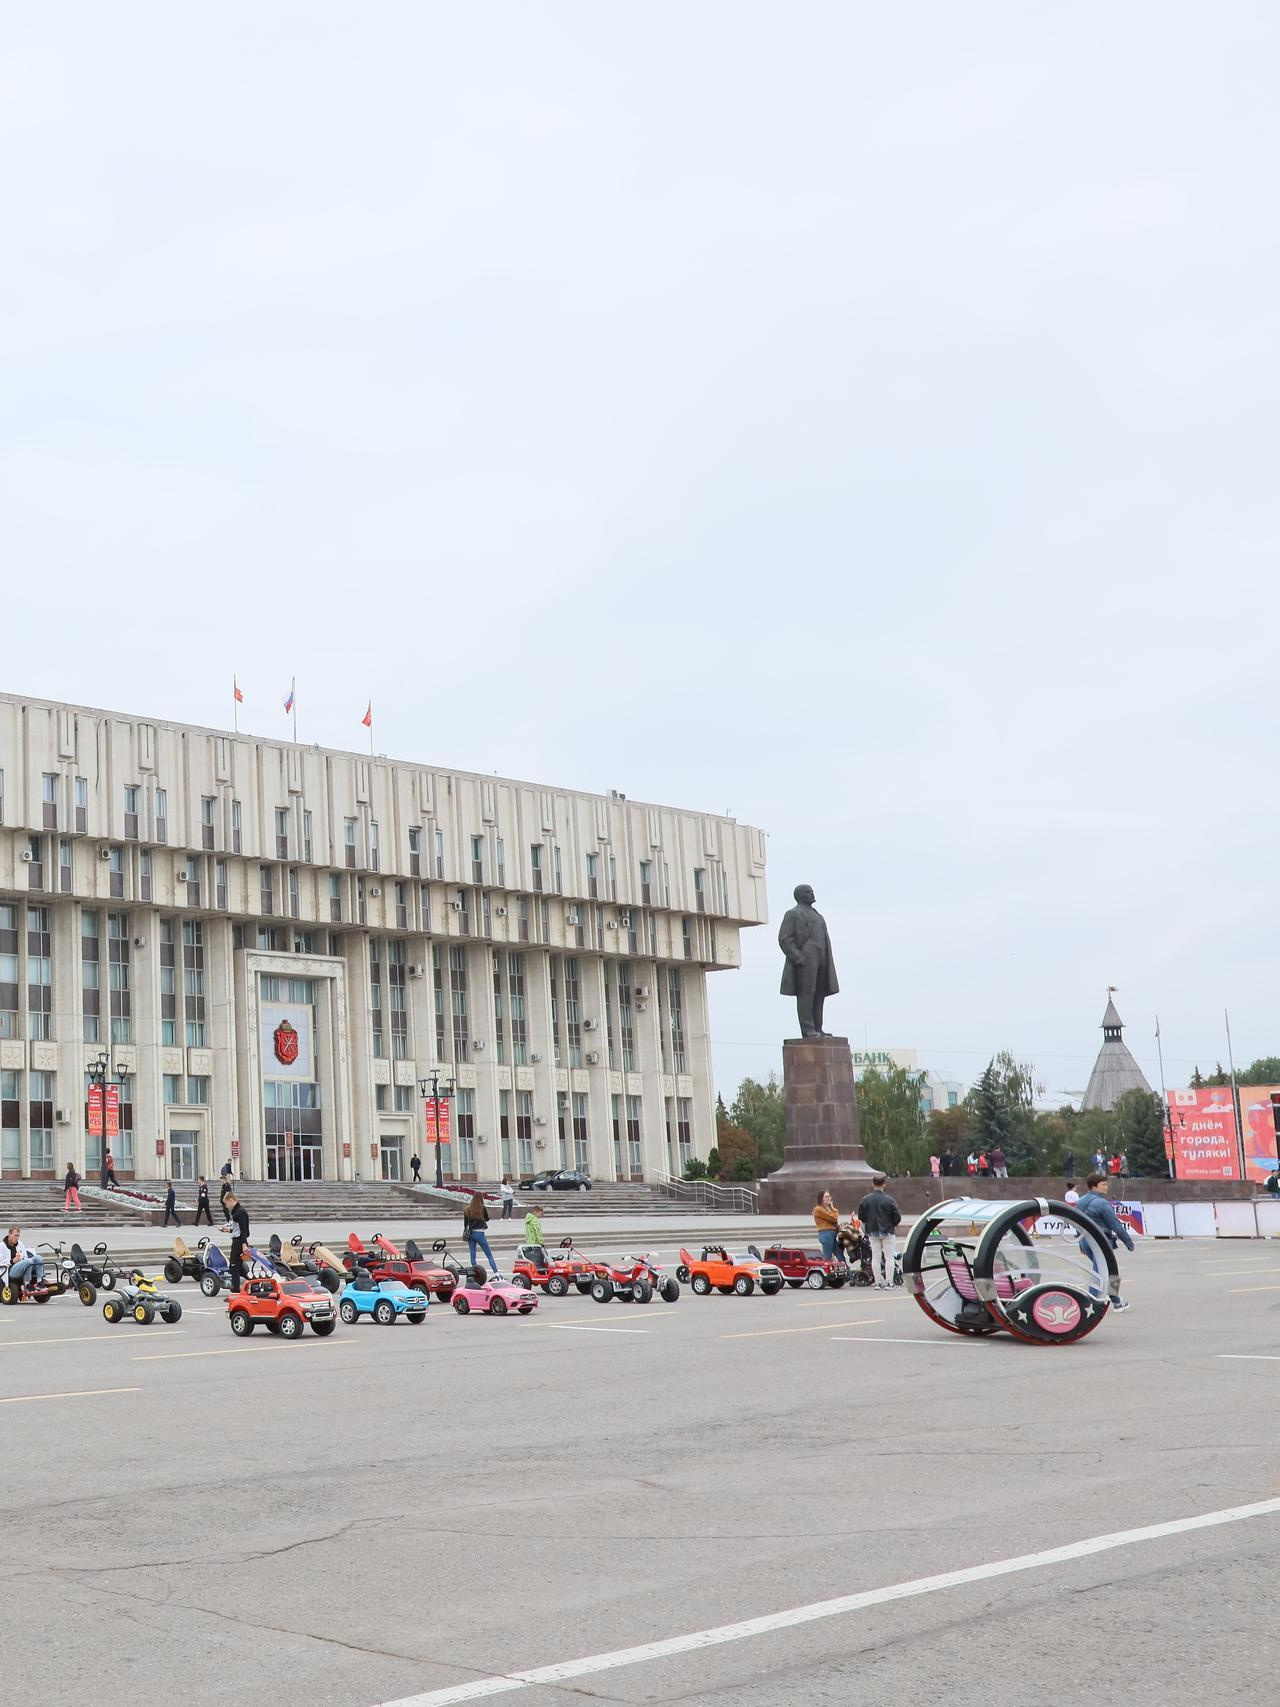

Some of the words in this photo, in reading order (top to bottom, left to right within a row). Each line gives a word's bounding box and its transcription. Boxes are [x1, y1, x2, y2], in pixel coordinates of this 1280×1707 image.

[851, 1051, 891, 1064] БАНК
[1191, 1119, 1224, 1132] днём
[1180, 1135, 1229, 1147] города,
[1182, 1147, 1231, 1161] туляки!
[1043, 1222, 1071, 1230] ТУЛА
